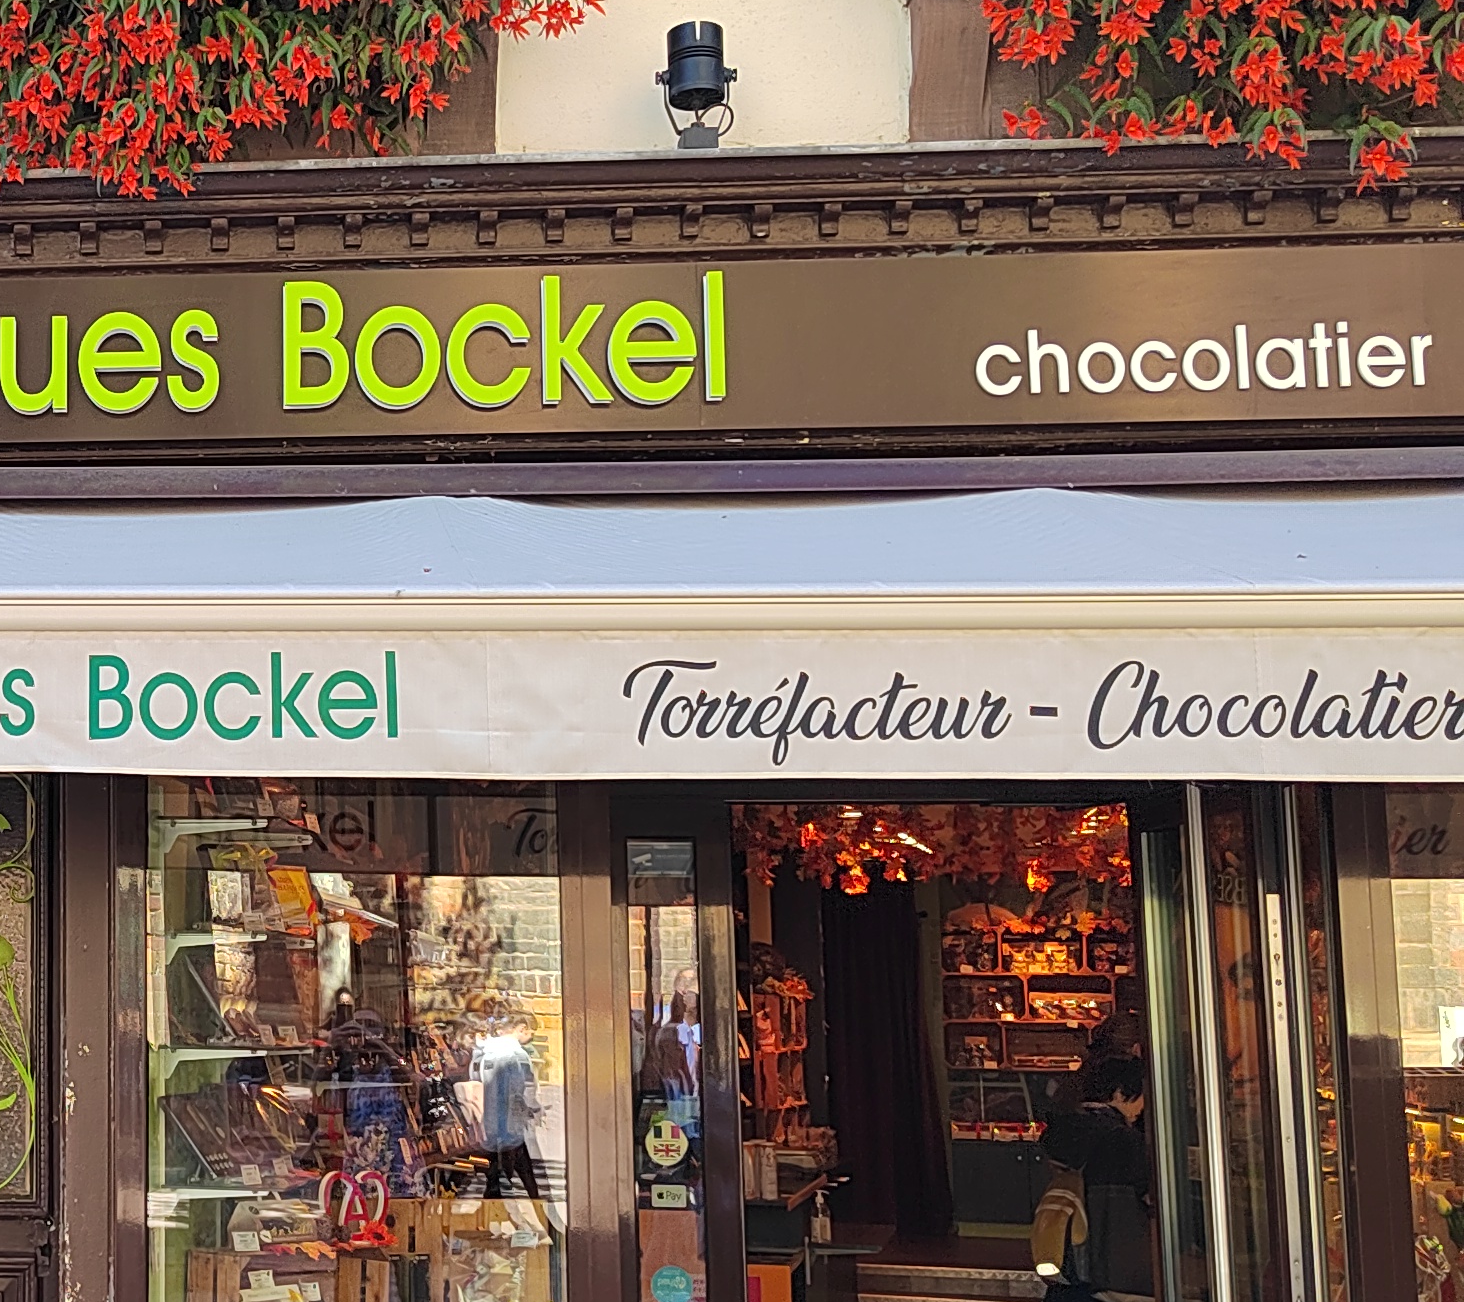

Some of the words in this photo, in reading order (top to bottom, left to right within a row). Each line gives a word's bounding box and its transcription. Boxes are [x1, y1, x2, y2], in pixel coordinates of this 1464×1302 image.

[282, 271, 726, 410] Bockel
[975, 321, 1433, 397] chocolatier
[88, 651, 398, 741] Bockel
[623, 660, 1012, 766] Torréfacteur
[1088, 660, 1464, 750] Chocolatier
[665, 1189, 683, 1202] Pay
